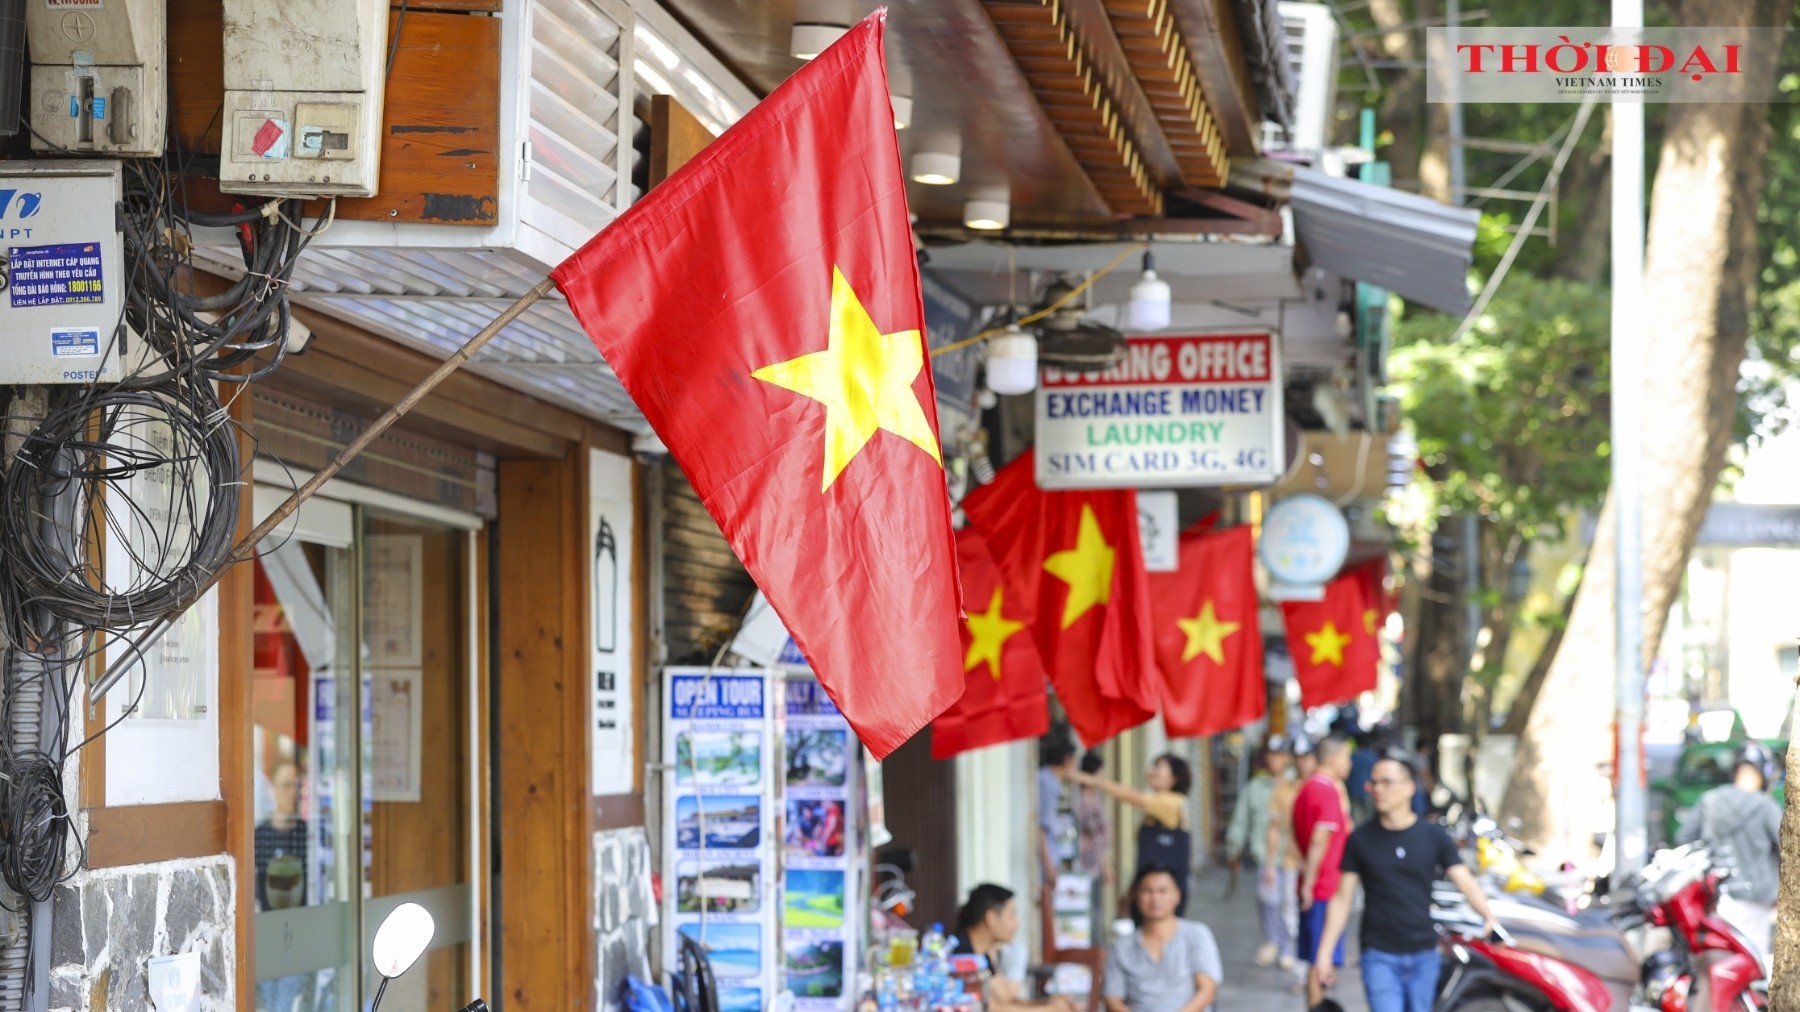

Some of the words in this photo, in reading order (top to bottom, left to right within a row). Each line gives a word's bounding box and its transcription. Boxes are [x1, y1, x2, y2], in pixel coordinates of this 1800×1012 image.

[36, 258, 64, 268] INTERNET
[79, 256, 99, 266] QUANG
[55, 270, 70, 278] THEO
[68, 280, 101, 292] 18001166
[1178, 339, 1267, 381] OFFICE
[1047, 389, 1171, 419] EXCHANGE
[1182, 388, 1265, 414] MONEY
[1087, 419, 1224, 446] LAUNDRY
[1048, 452, 1096, 474] SIM
[1104, 450, 1178, 473] CARD
[1234, 446, 1266, 469] 4G
